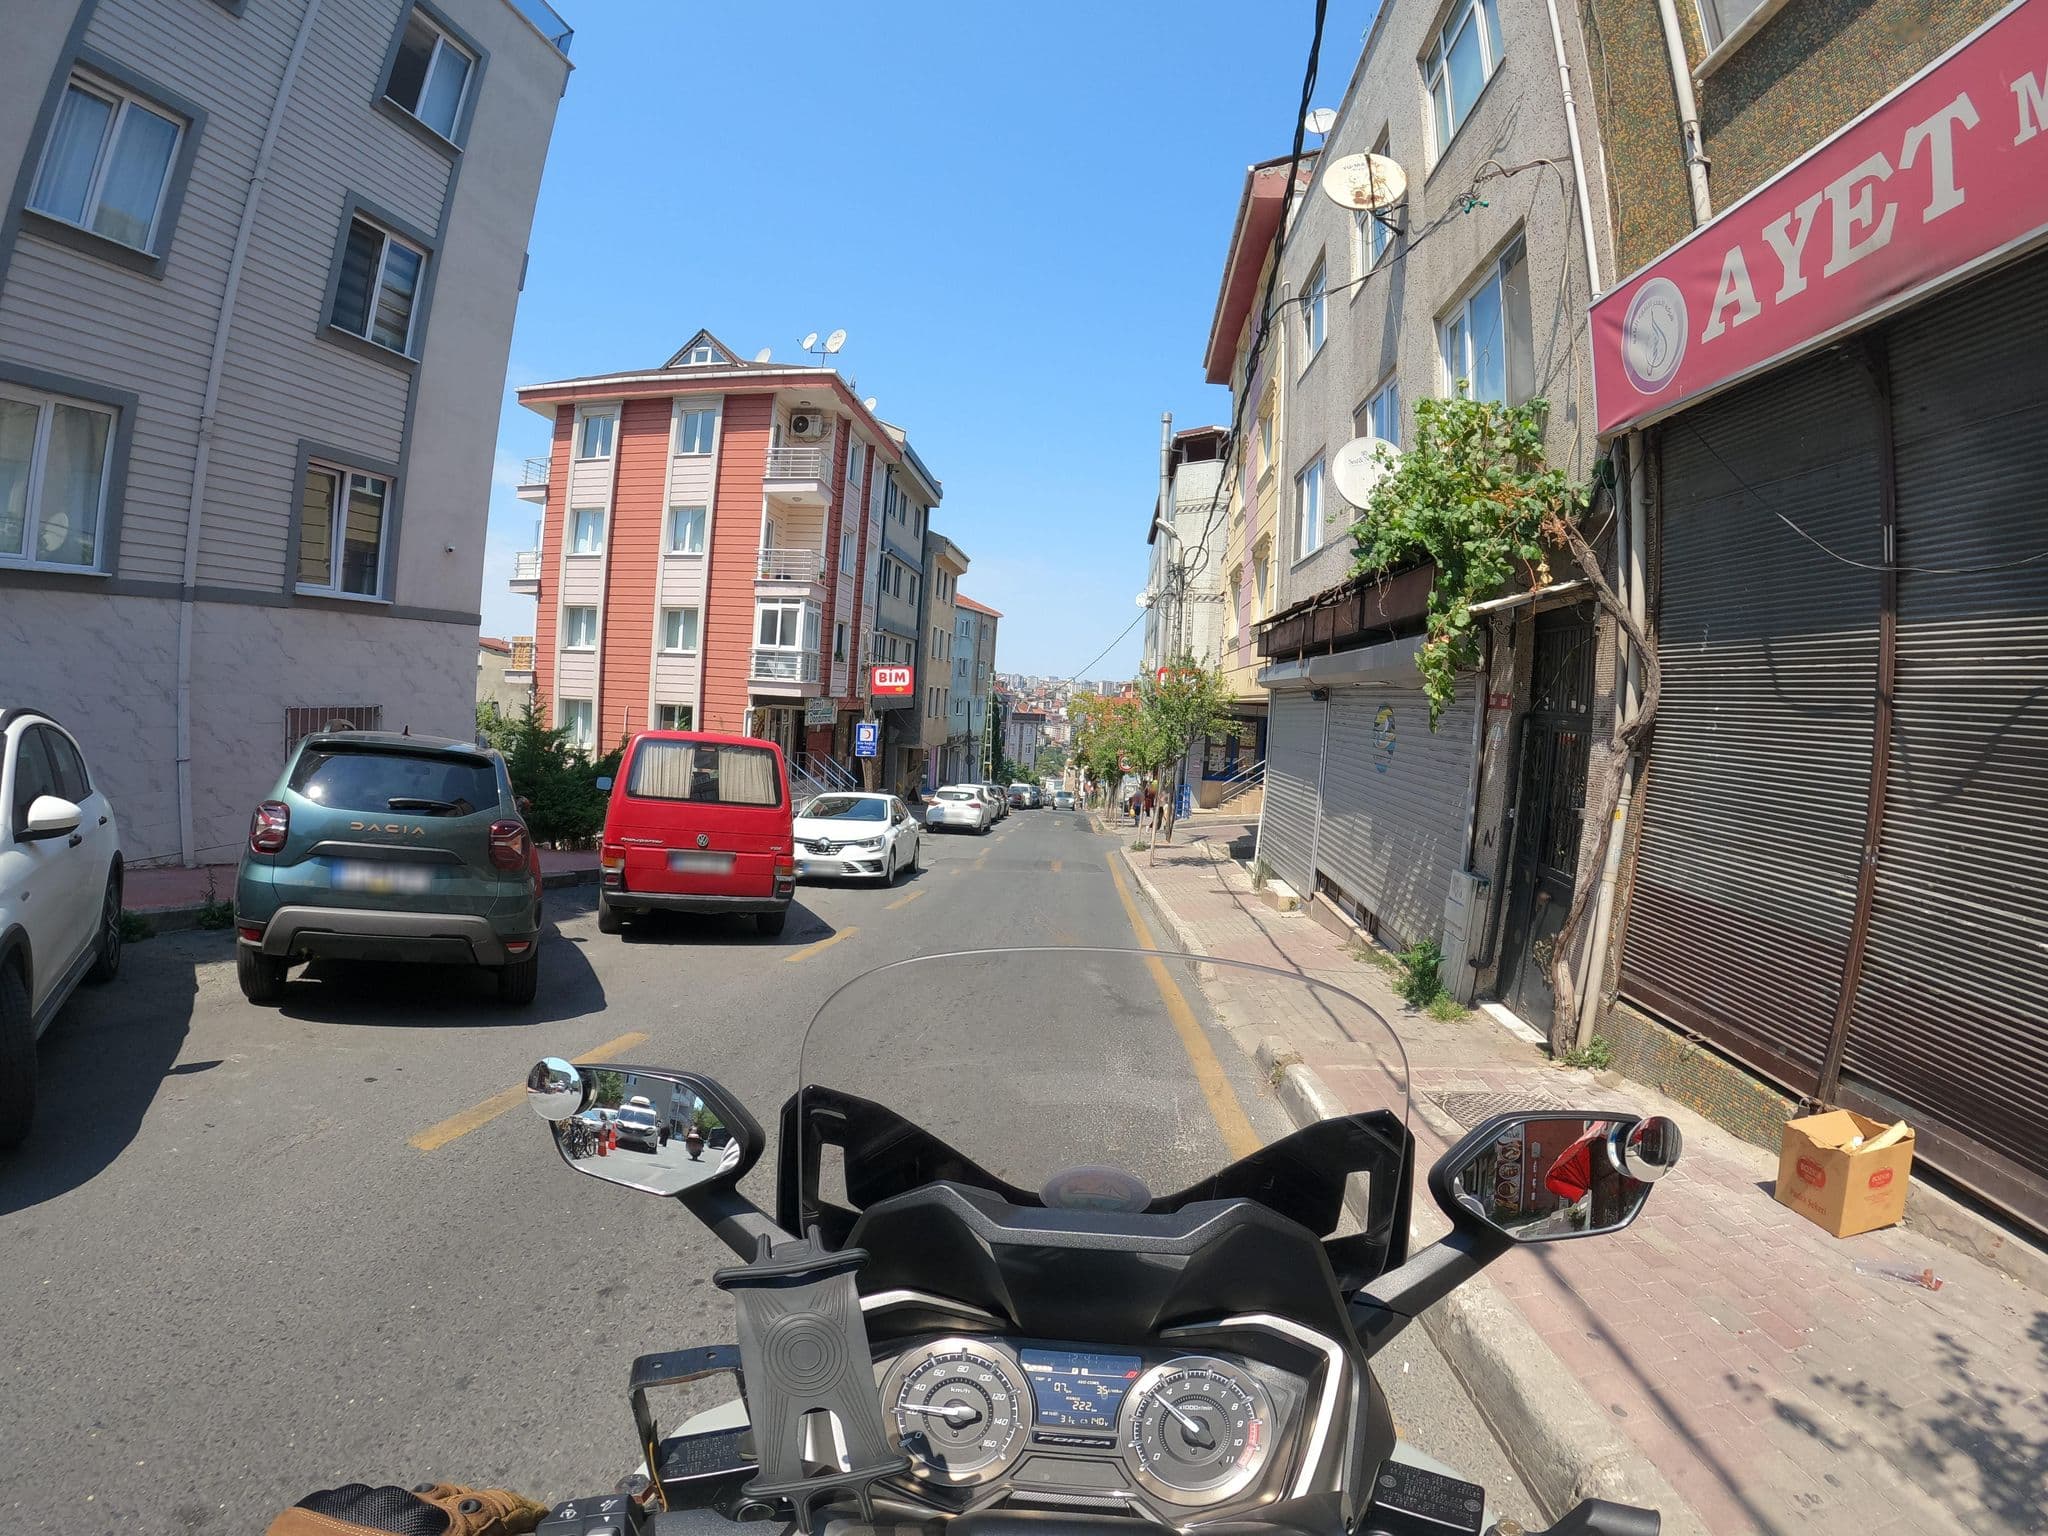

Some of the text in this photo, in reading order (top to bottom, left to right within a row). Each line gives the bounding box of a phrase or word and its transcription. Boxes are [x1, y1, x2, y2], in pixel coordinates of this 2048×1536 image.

[1701, 92, 1981, 345] AYET
[350, 821, 425, 835] DACIA
[933, 1369, 946, 1377] 60
[957, 1365, 970, 1373] 80
[979, 1374, 993, 1382] 100
[913, 1383, 926, 1391] 40
[1184, 1382, 1191, 1390] 5
[1203, 1383, 1210, 1391] 6
[992, 1393, 1006, 1401] 120
[1072, 1400, 1092, 1411] 222
[994, 1417, 1008, 1426] 140
[1145, 1417, 1152, 1425] 2
[983, 1439, 998, 1448] 160
[1147, 1436, 1152, 1444] 1
